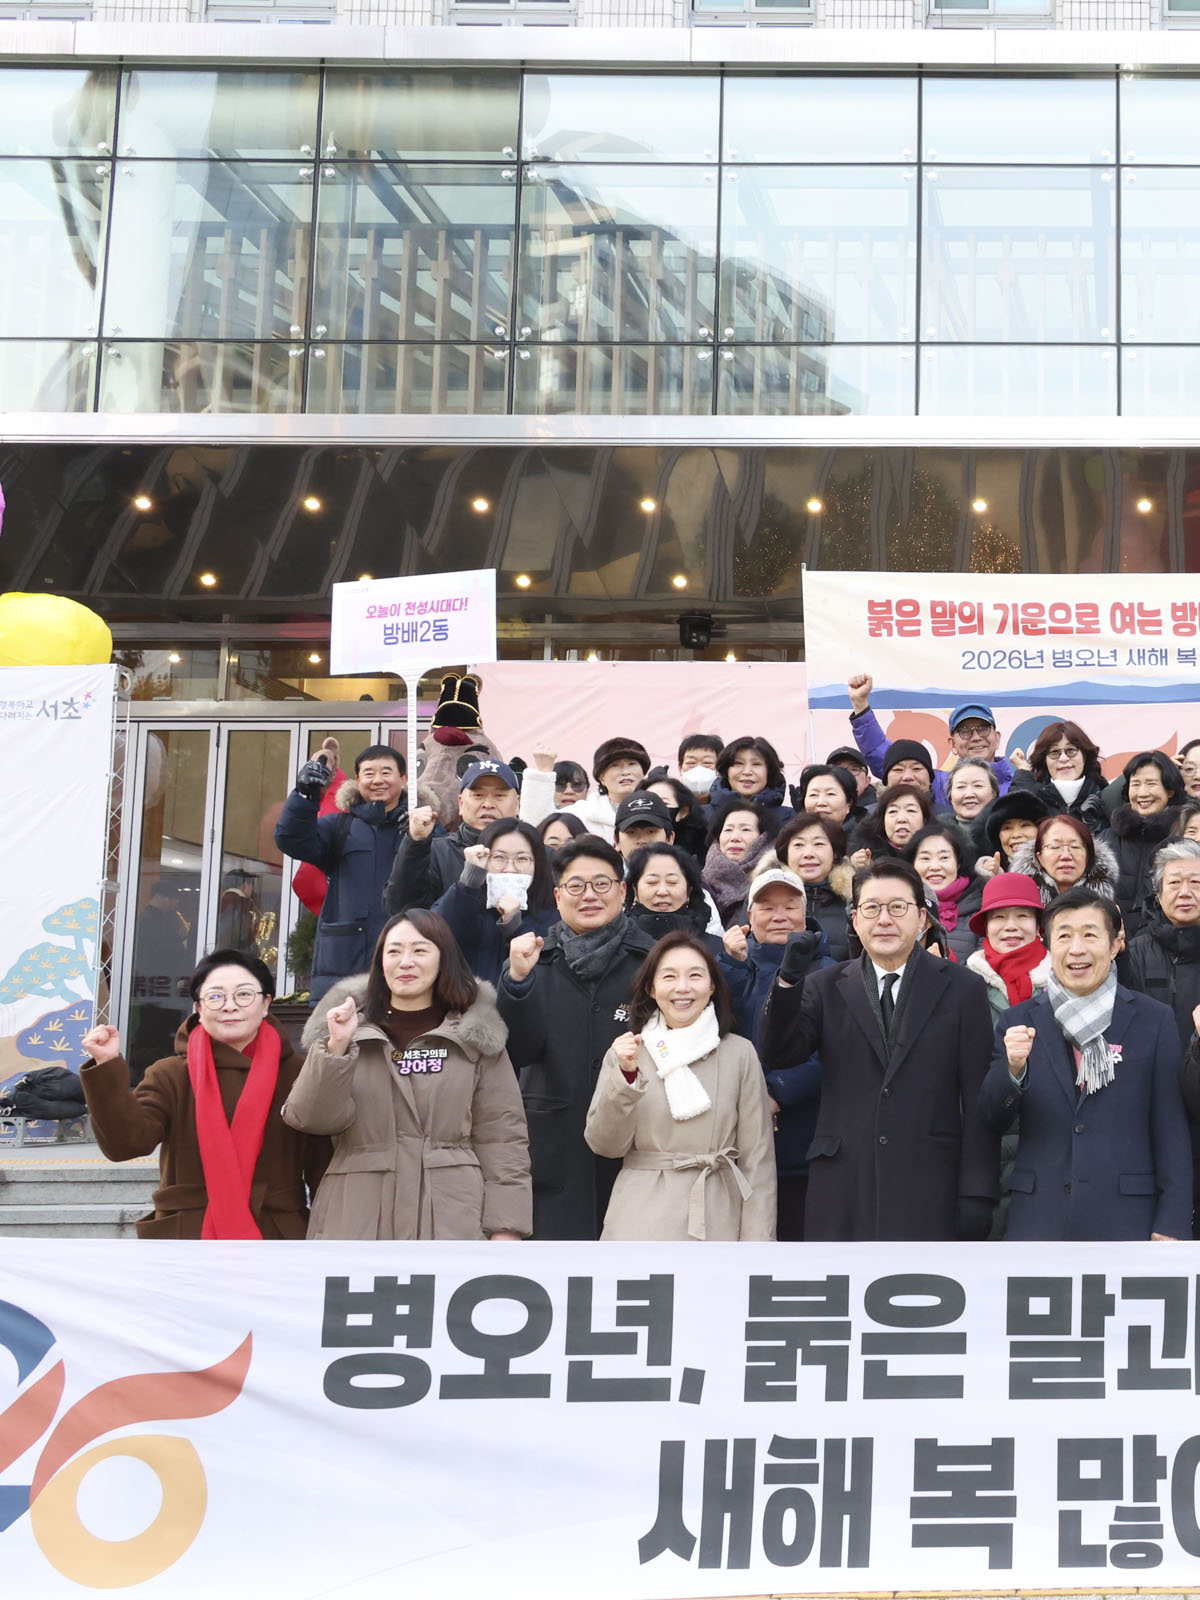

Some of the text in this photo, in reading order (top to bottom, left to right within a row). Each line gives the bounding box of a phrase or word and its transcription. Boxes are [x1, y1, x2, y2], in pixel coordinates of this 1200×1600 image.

[365, 597, 469, 619] 오늘이 전성시대다!
[867, 598, 922, 637] 붉은
[930, 600, 985, 637] 말의
[993, 602, 1101, 636] 기운으로
[1110, 601, 1163, 636] 여는
[383, 619, 449, 646] 방배2동
[961, 649, 1045, 670] 2026년
[1052, 648, 1118, 669] 병오년
[1126, 648, 1169, 667] 새해
[1176, 647, 1197, 667] 복
[36, 697, 82, 721] 서초
[479, 760, 500, 773] NY
[403, 1049, 448, 1060] 서초구의원
[397, 1058, 442, 1075] 강여정
[321, 1273, 706, 1410] 병오년,
[743, 1273, 967, 1402] 붉은
[638, 1433, 874, 1570] 새해
[909, 1436, 1017, 1570] 복
